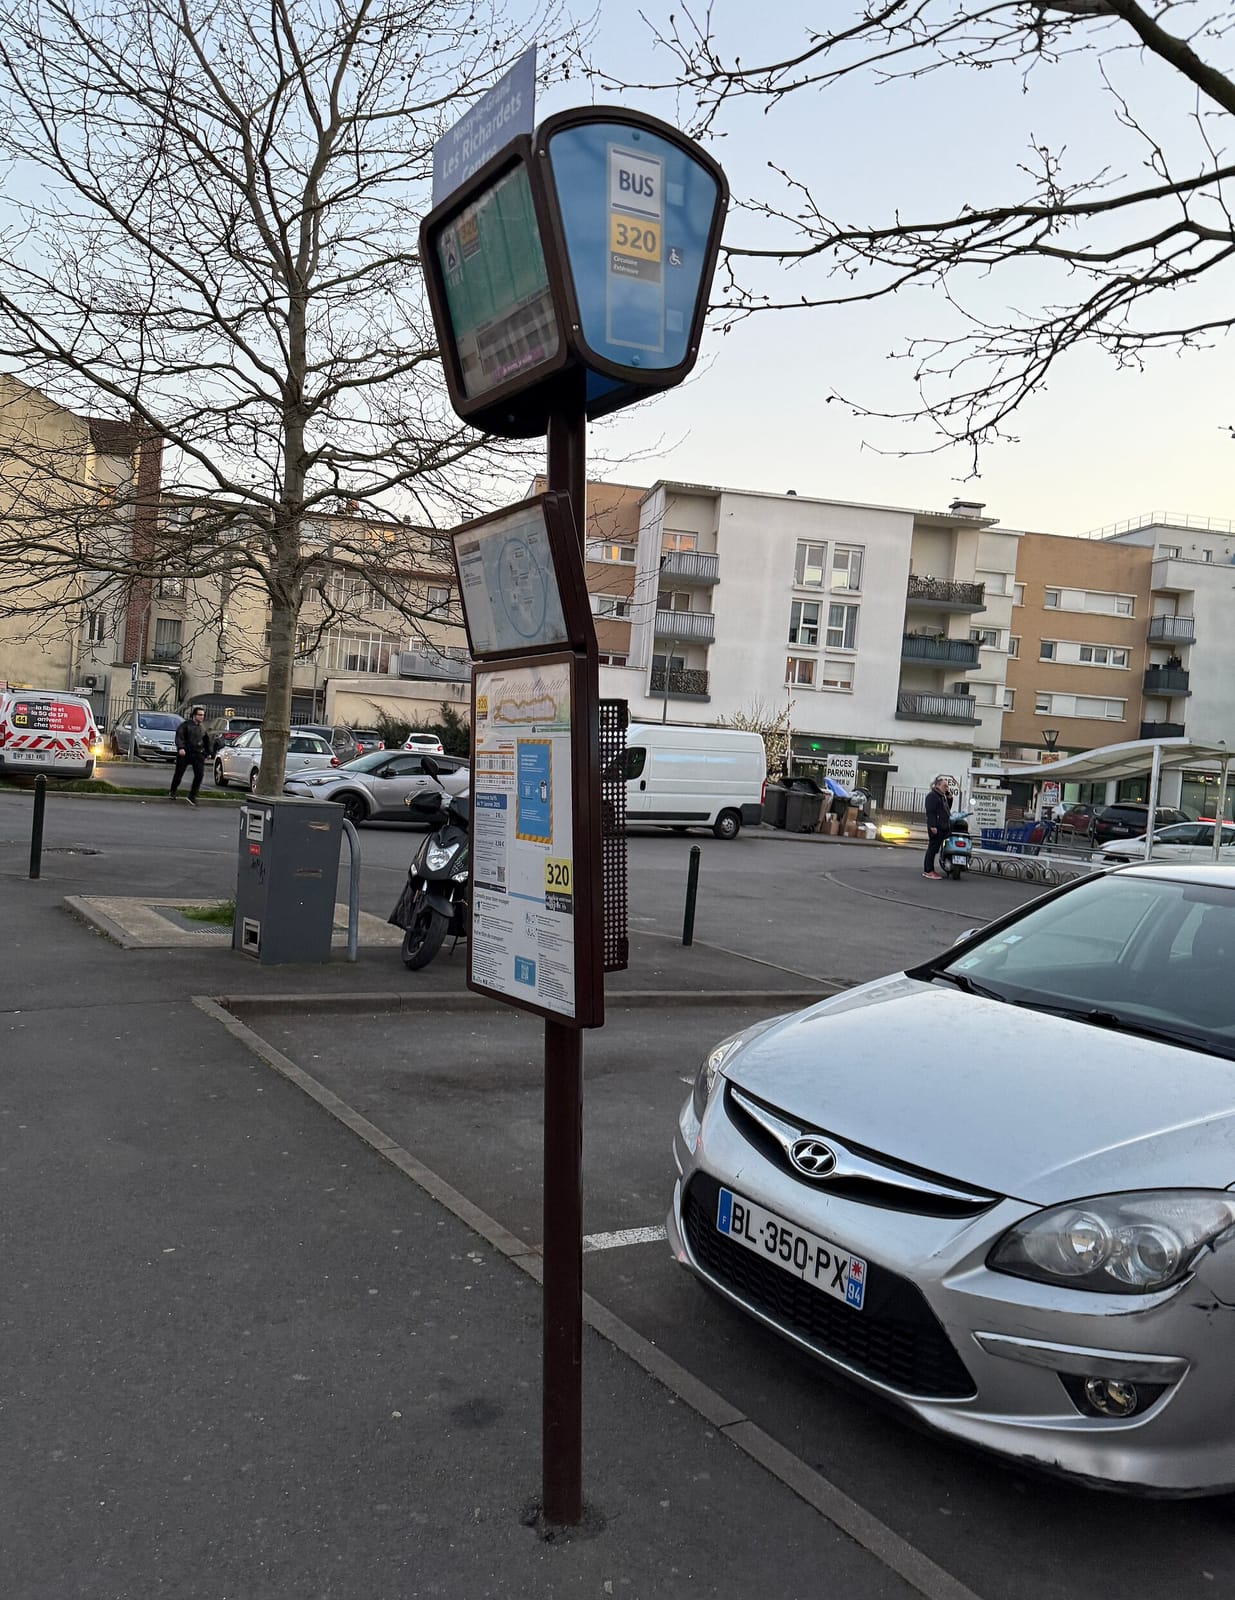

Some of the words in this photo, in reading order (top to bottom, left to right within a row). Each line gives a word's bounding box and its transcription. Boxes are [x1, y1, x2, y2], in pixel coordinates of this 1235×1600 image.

[443, 151, 460, 181] Les
[463, 92, 522, 162] Richardets
[619, 168, 654, 198] BUS
[616, 223, 657, 253] 320
[827, 768, 855, 778] PARKING
[830, 759, 853, 768] ACCES
[547, 863, 569, 886] 320
[722, 1215, 727, 1225] F
[848, 1283, 861, 1304] 94
